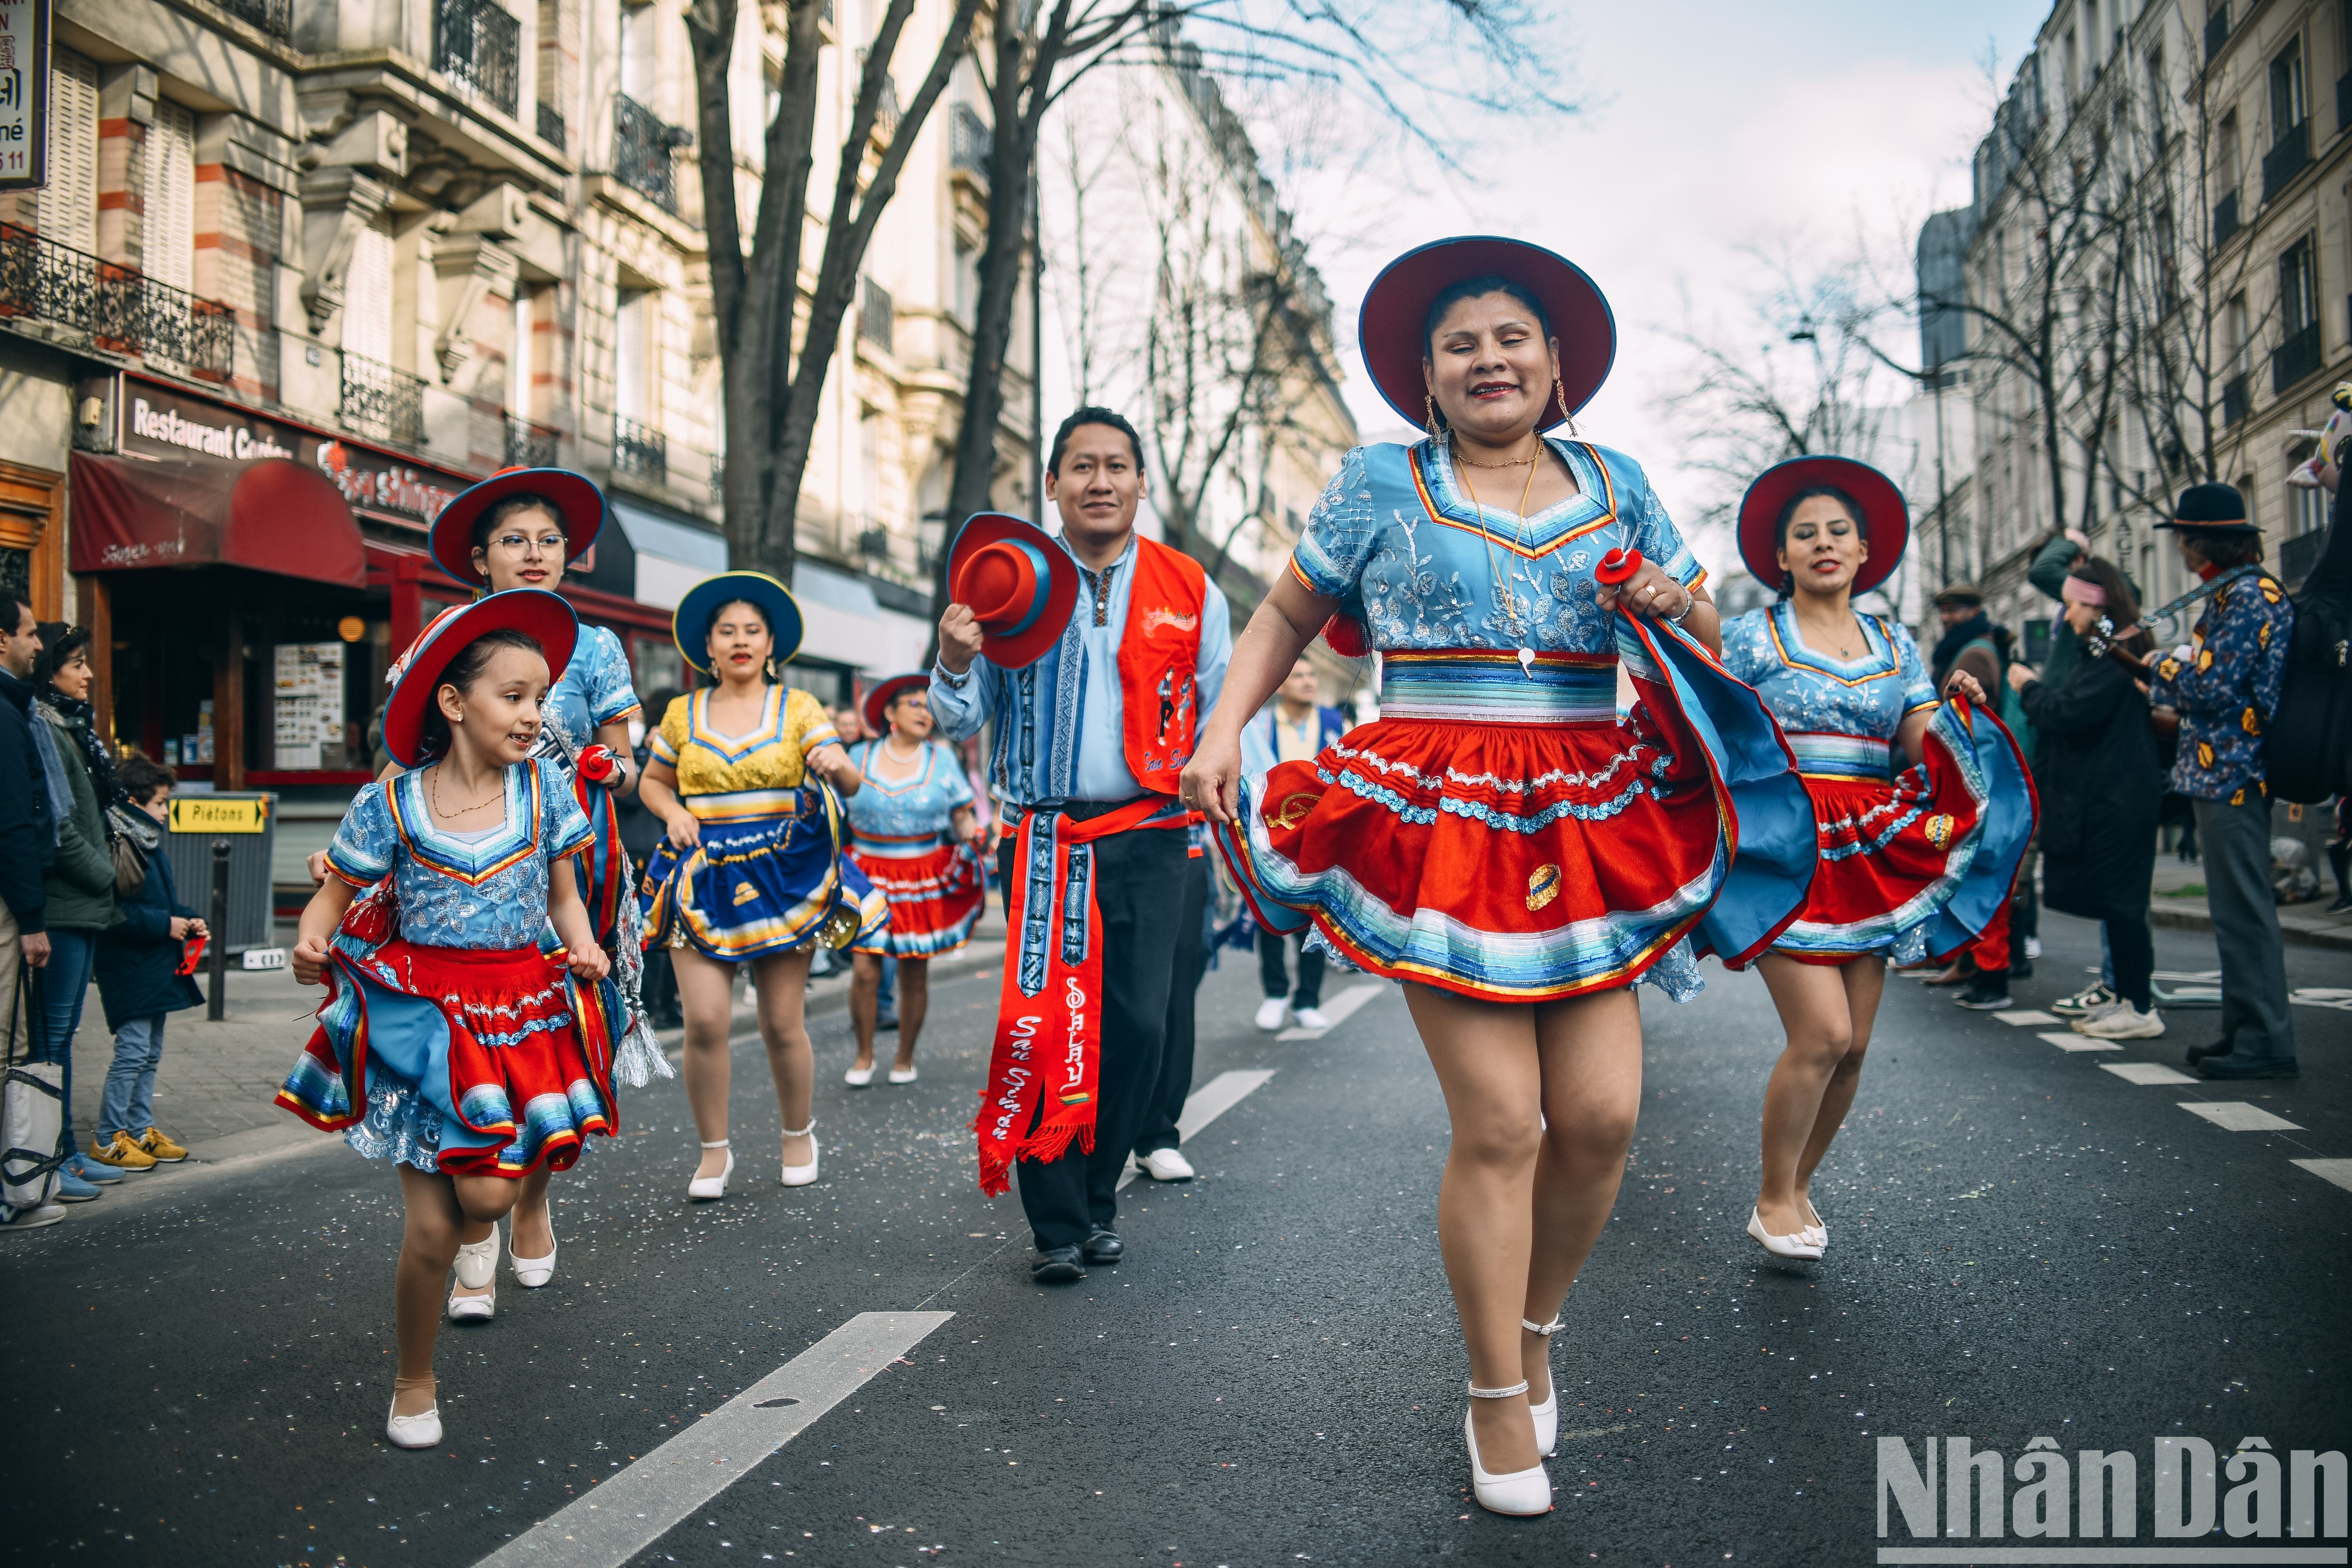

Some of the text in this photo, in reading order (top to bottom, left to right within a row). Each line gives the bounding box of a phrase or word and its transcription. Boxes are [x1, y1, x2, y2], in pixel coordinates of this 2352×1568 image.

[134, 397, 234, 460] Restaurant
[193, 804, 242, 821] Piétons
[1009, 1016, 1042, 1061] San
